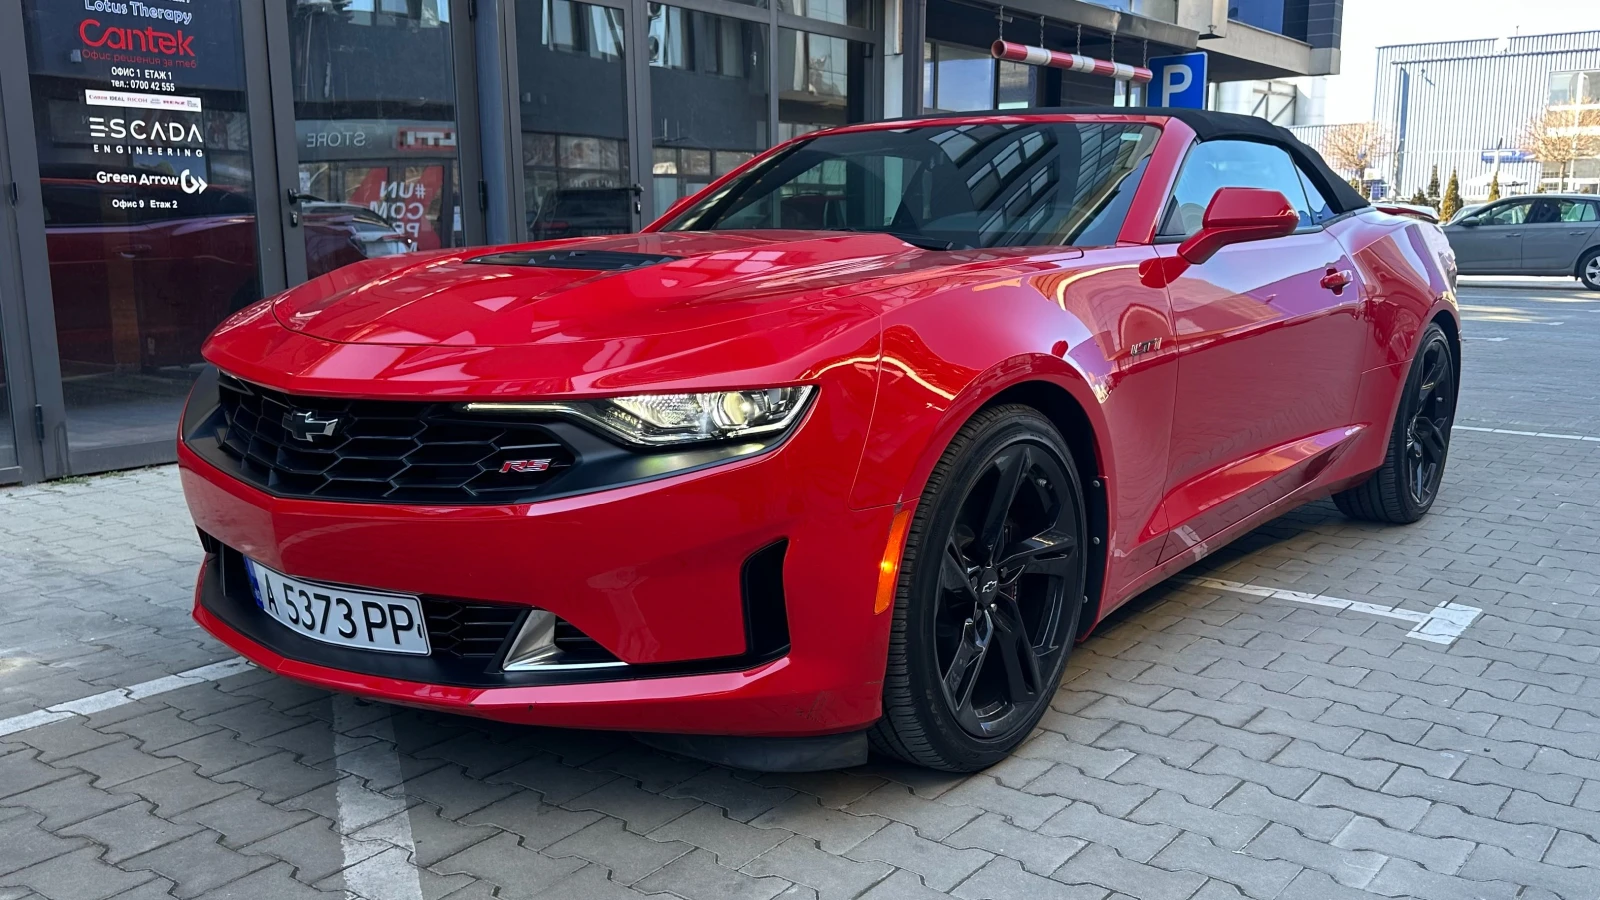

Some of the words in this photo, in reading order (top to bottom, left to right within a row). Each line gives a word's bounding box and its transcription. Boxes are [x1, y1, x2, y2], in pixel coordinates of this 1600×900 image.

[84, 0, 128, 14] Lotus
[130, 1, 192, 25] Therapy
[79, 19, 195, 56] Cantek
[82, 49, 111, 60] Офис
[114, 54, 161, 66] решения
[163, 60, 173, 68] за
[112, 67, 135, 77] ОФИС
[136, 69, 141, 77] 1
[145, 70, 167, 80] ЕТАЖ
[168, 72, 172, 80] 1
[130, 80, 148, 89] 0700
[150, 81, 160, 90] 42
[161, 82, 175, 92] 555
[1162, 64, 1193, 107] P
[89, 117, 203, 143] ESCADA
[93, 144, 203, 158] ENGINEERING
[96, 171, 137, 184] Green
[139, 173, 179, 185] Arrow
[112, 199, 138, 209] Офис
[139, 200, 145, 208] 9
[150, 200, 171, 209] Етаж
[172, 200, 178, 208] 2
[499, 459, 551, 473] RS
[265, 573, 279, 616] A
[283, 582, 357, 639] 5373
[362, 600, 414, 645] PP
